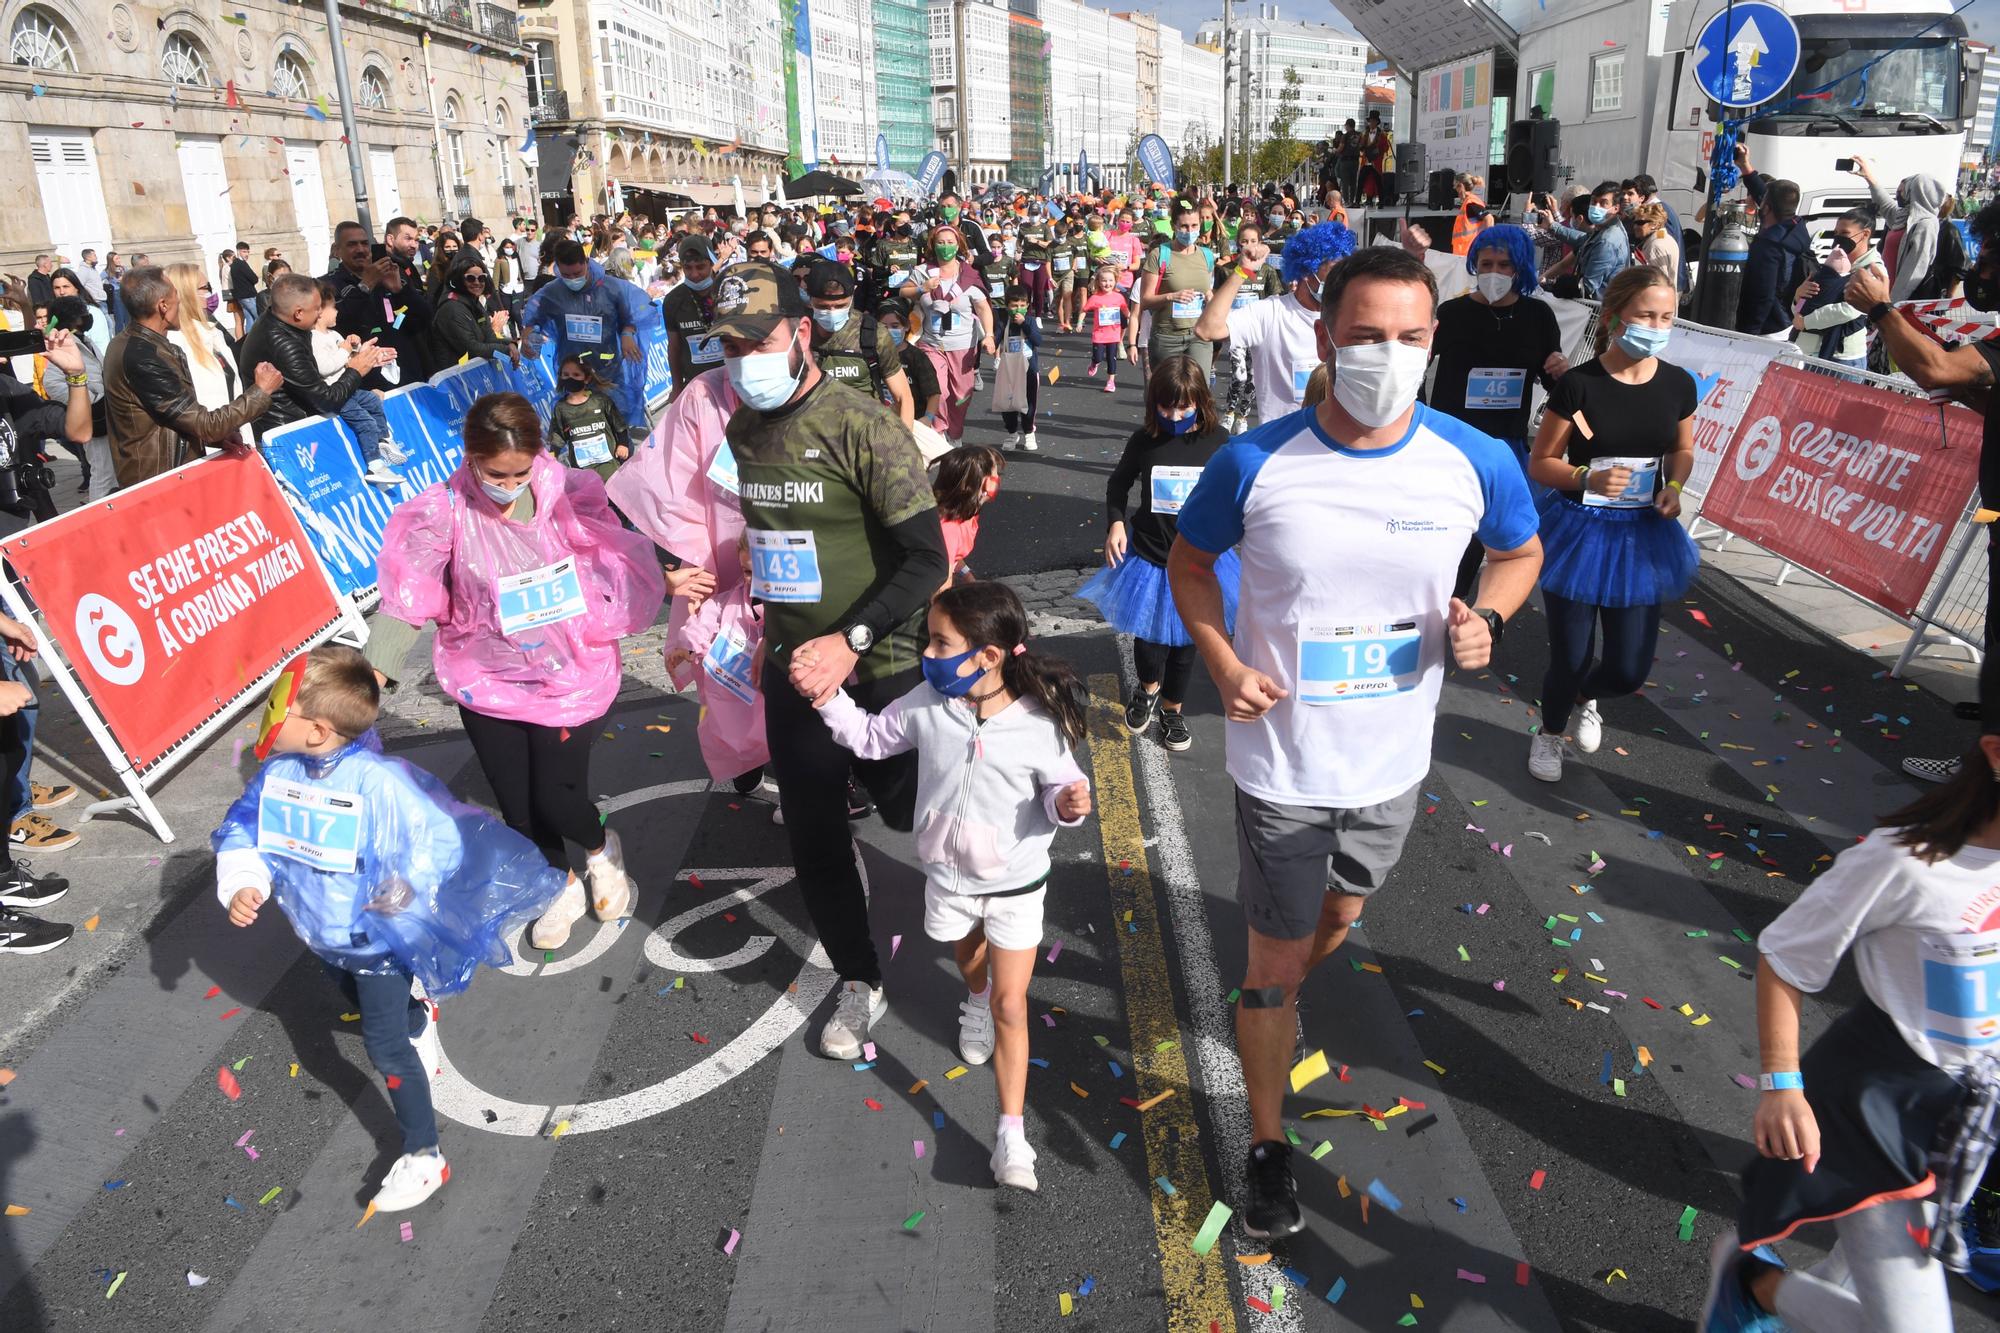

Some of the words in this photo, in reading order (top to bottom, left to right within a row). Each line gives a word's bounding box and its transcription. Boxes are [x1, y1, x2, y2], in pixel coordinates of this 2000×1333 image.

[835, 366, 860, 378] ENKI
[1485, 380, 1508, 397] 46
[1788, 420, 1815, 454] O
[1799, 427, 1921, 492] DEPORTE
[785, 481, 824, 503] ENKI
[1767, 464, 1835, 516] ESTÁ
[1821, 485, 1865, 528] DE
[1847, 498, 1943, 564] VOLTA
[127, 563, 165, 610] SE
[155, 543, 201, 596] CHE
[193, 510, 273, 575] PRESTA,
[756, 552, 800, 580] 143
[153, 606, 183, 658] Á
[170, 570, 257, 644] CORUÑA
[244, 536, 305, 597] TAMÉN
[517, 579, 565, 610] 115
[1342, 643, 1387, 676] 19
[1353, 681, 1389, 691] REPSOL
[281, 805, 336, 844] 117
